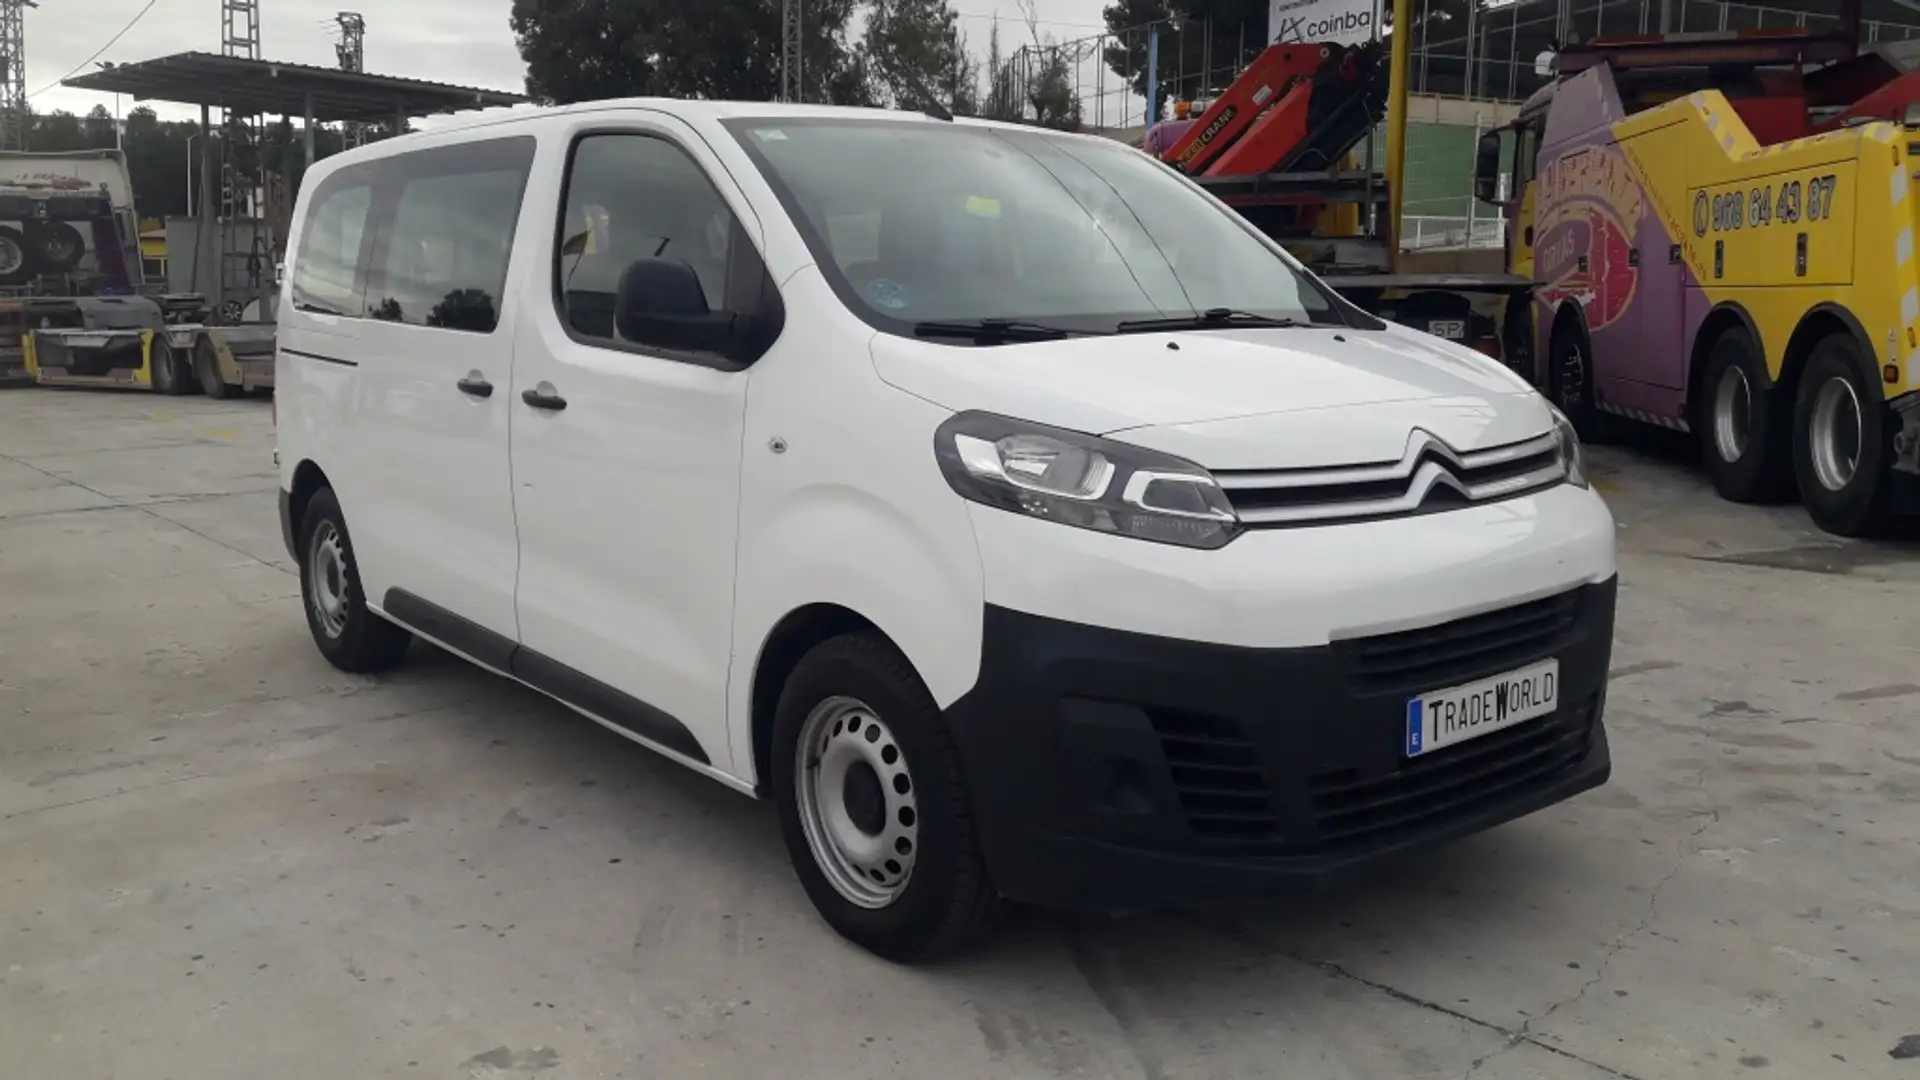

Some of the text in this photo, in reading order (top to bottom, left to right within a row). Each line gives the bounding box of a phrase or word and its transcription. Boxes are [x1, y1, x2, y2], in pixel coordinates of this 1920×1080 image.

[1306, 11, 1370, 37] coinba
[1712, 174, 1837, 232] 968 64 43 87
[1411, 733, 1419, 746] E
